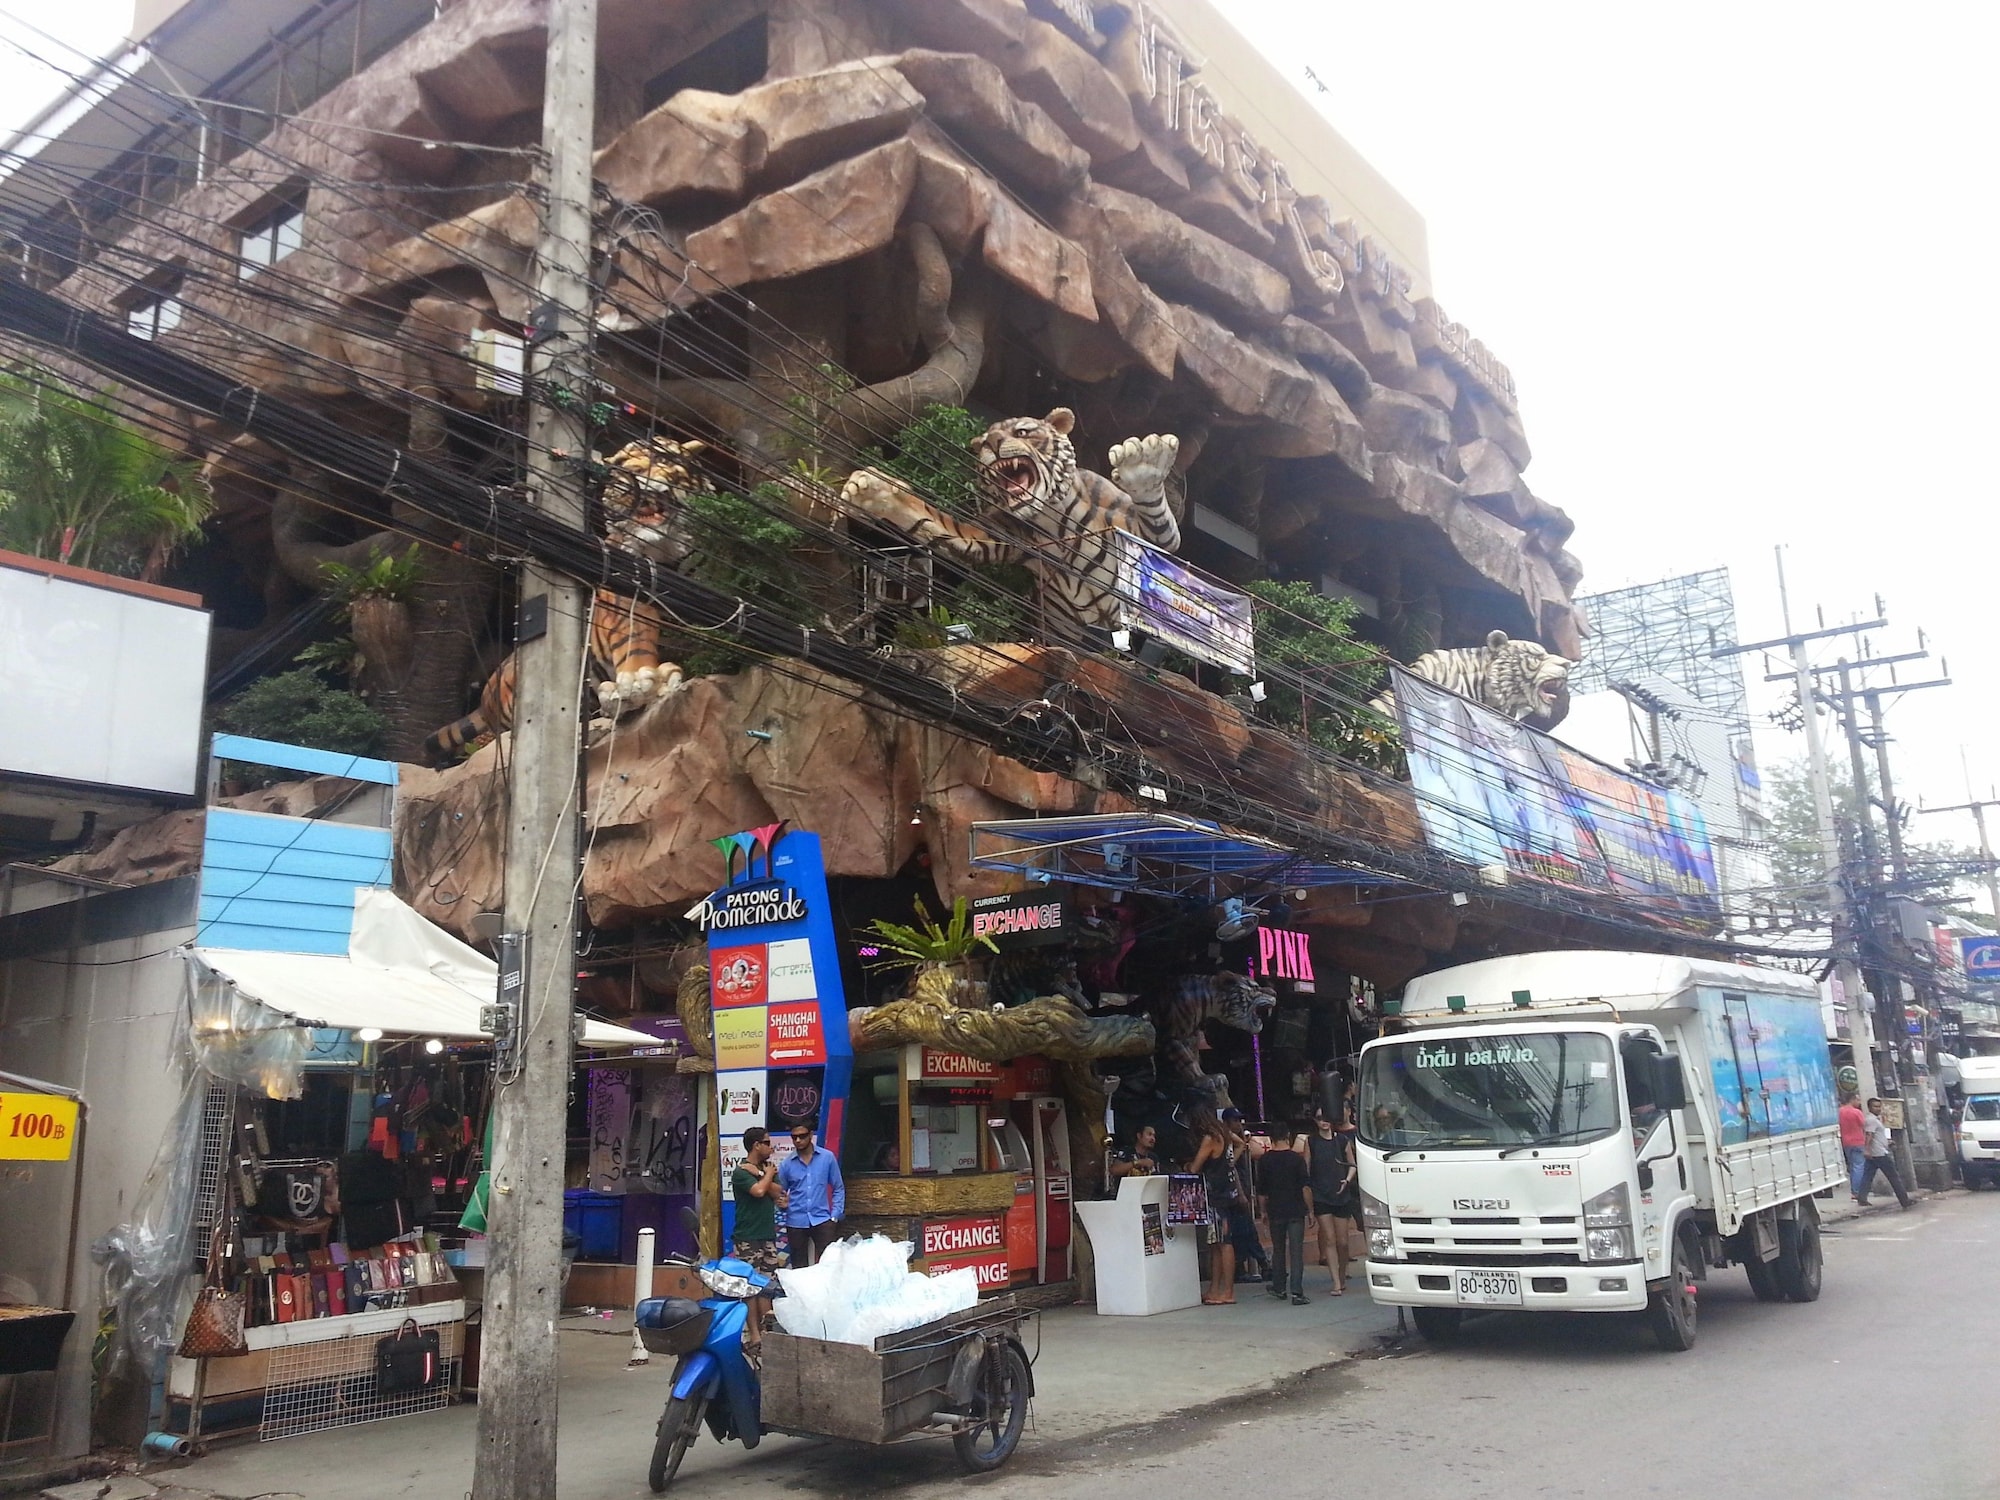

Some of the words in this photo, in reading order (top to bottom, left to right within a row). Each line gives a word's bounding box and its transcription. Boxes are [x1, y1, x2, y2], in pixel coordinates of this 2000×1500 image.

[726, 888, 780, 908] PATONG
[974, 895, 1012, 908] CURRENCY
[699, 887, 805, 932] Promenade
[973, 903, 1062, 938] EXCHANGE
[1257, 926, 1315, 981] PINK
[770, 1012, 817, 1027] SHANGHAI
[777, 1025, 809, 1039] TAILOR
[927, 1056, 992, 1073] EXCHANGE
[1416, 1046, 1457, 1069] น้ำดื่ม
[1464, 1045, 1539, 1067] เอส.พี.เอ.
[958, 1158, 975, 1166] OPEN
[1453, 1199, 1511, 1210] ISUZU
[925, 1224, 948, 1233] CURRENCY
[924, 1225, 1001, 1252] EXCHANGE
[929, 1263, 952, 1272] CURRENCY
[1460, 1277, 1517, 1295] 80-8370
